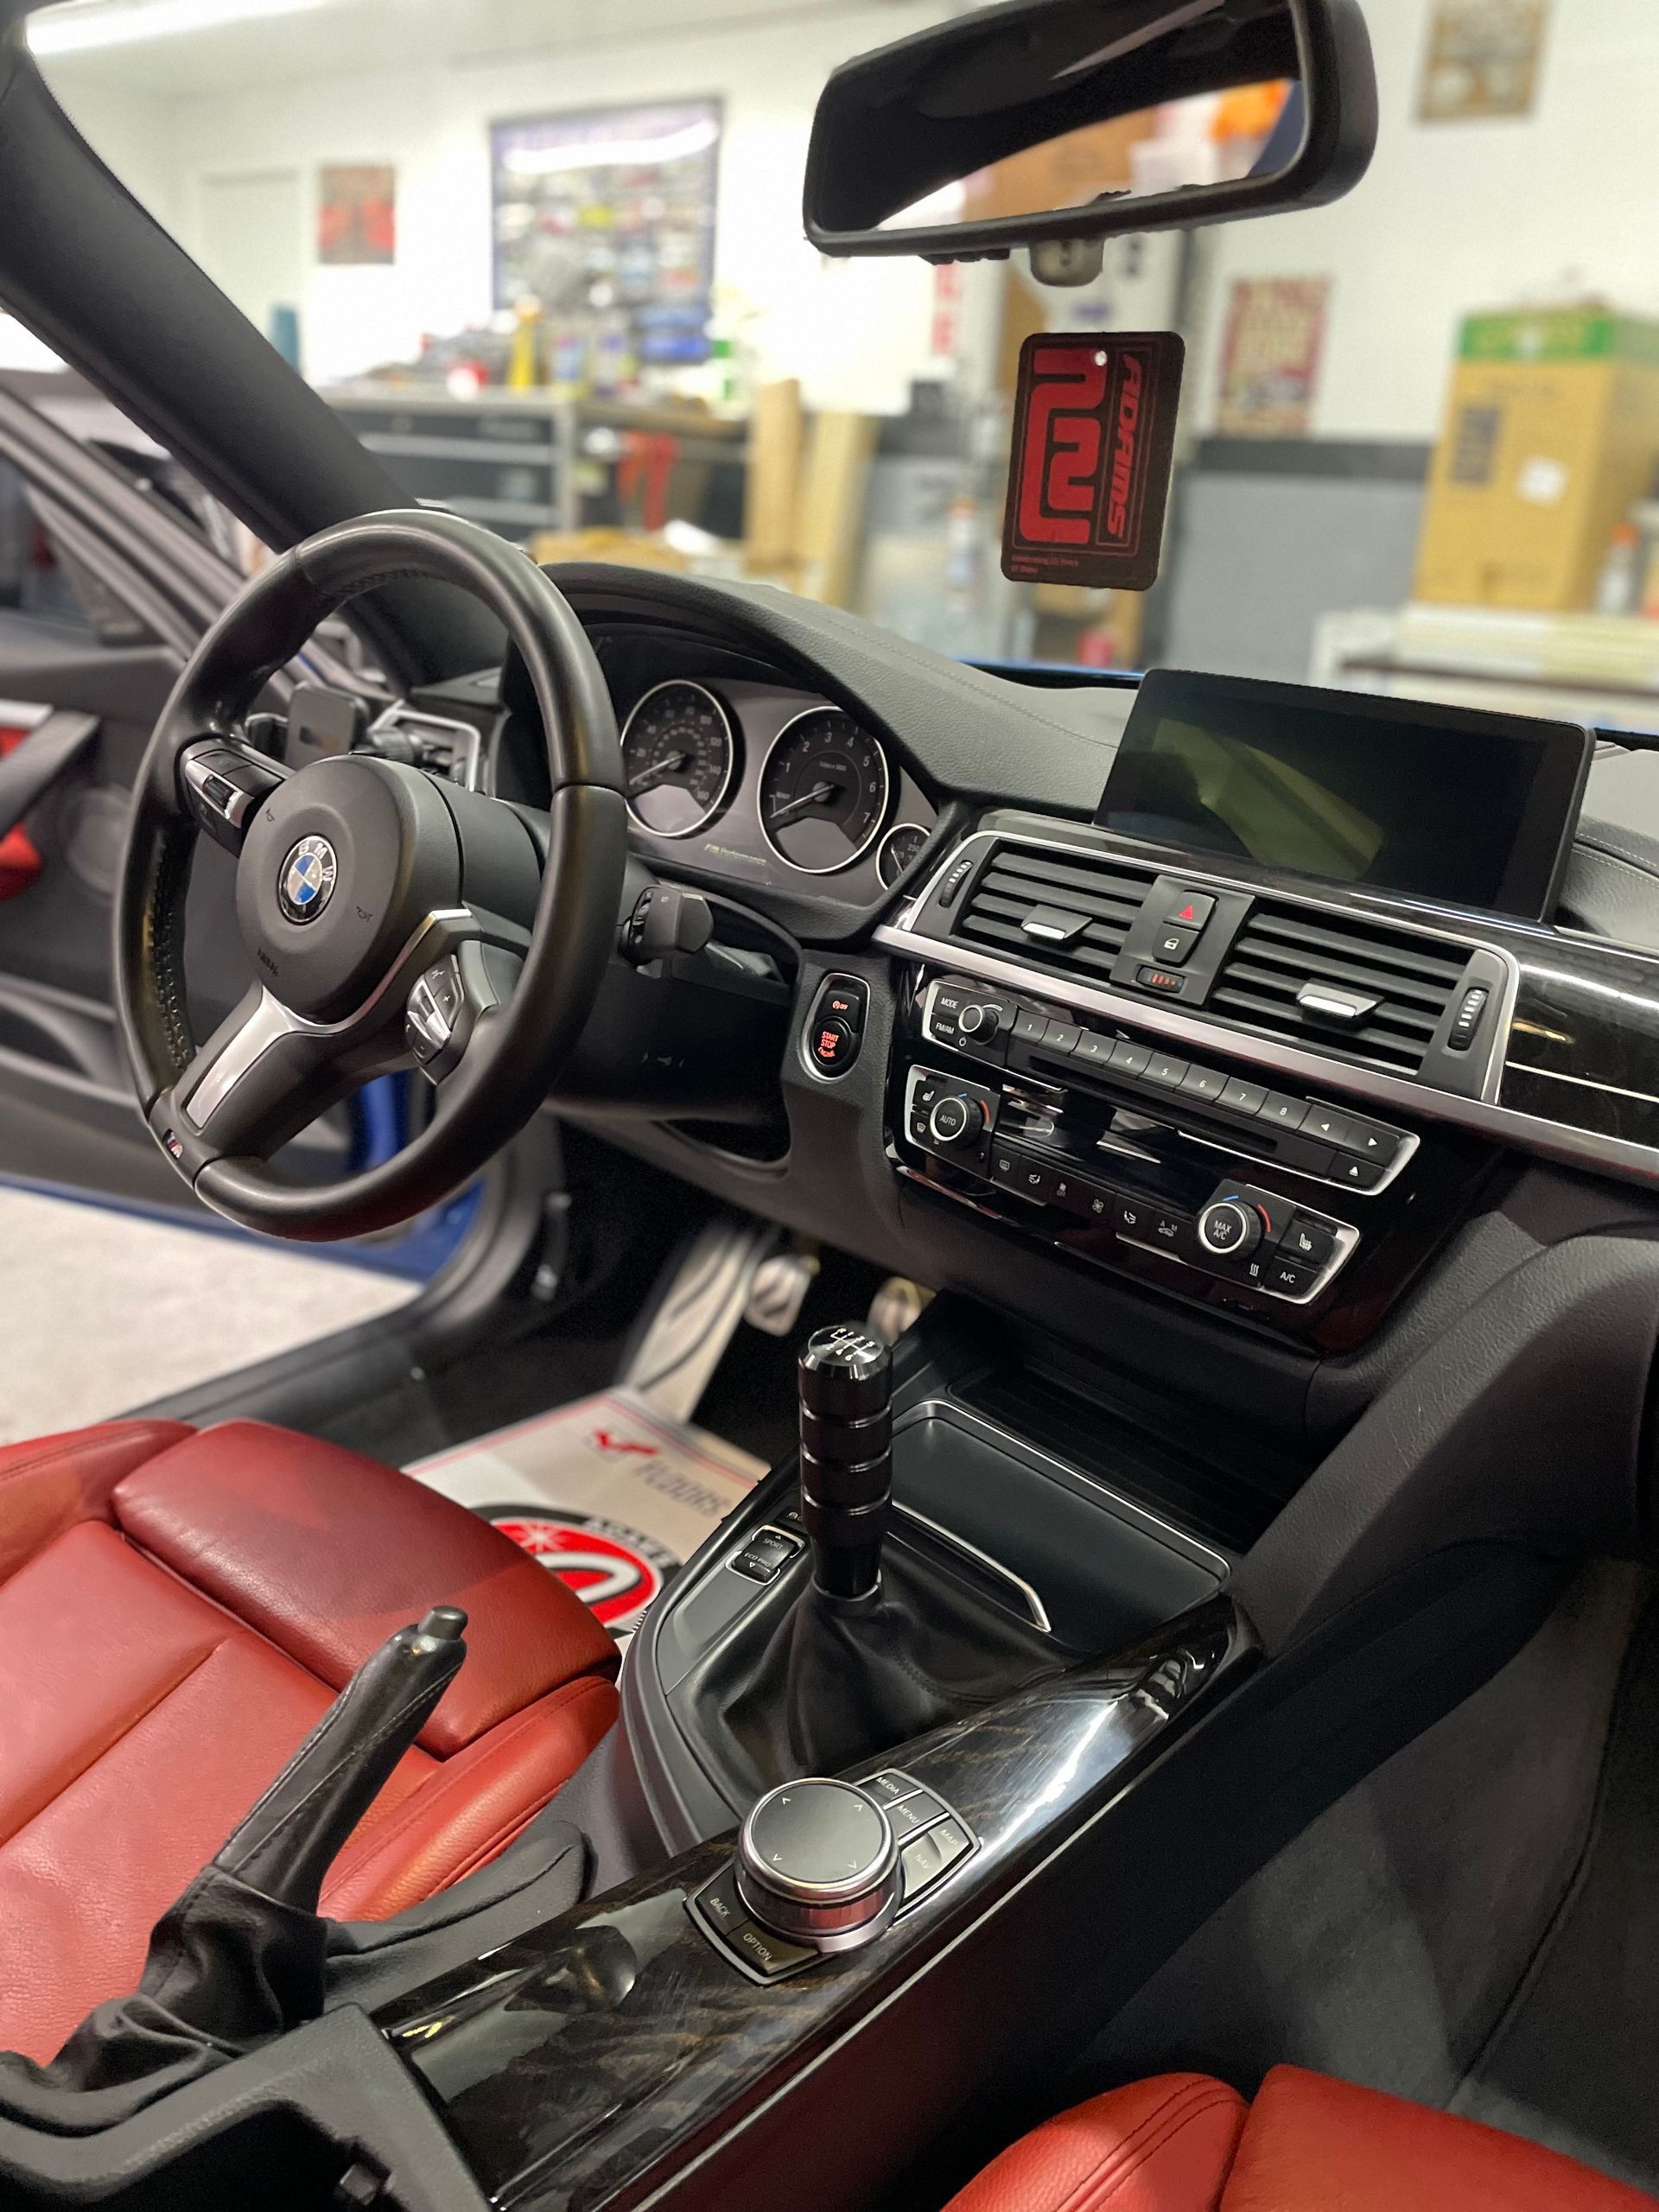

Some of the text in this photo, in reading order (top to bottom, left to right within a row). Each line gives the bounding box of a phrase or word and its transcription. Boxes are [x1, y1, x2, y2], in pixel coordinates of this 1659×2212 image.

[824, 731, 833, 743] 3
[847, 736, 855, 748] 4
[802, 741, 810, 753] 2
[785, 761, 791, 773] 1
[862, 755, 871, 767] 5
[869, 781, 877, 793] 6
[862, 811, 871, 823] 7
[298, 841, 334, 881] BMW
[940, 996, 958, 1010] MODE
[1027, 1023, 1033, 1032] 1
[822, 1031, 839, 1042] START
[1055, 1033, 1065, 1043] 2
[821, 1039, 836, 1049] STOP
[1090, 1045, 1098, 1054] 3
[1160, 1067, 1169, 1077] 5
[1198, 1079, 1207, 1089] 6
[1280, 1107, 1287, 1116] 8
[939, 1114, 957, 1128] AUTO
[1213, 1219, 1232, 1234] MAX
[1213, 1229, 1228, 1241] A/C
[1280, 1271, 1296, 1284] A/C
[762, 1537, 785, 1550] SPORT
[743, 1551, 772, 1568] ECO PRO
[875, 1776, 900, 1796] MEDIA
[897, 1804, 920, 1825] MENU
[939, 1828, 959, 1847] MAP
[914, 1853, 932, 1870] NAV
[709, 1897, 732, 1918] BACK
[742, 1932, 772, 1961] OPTION
